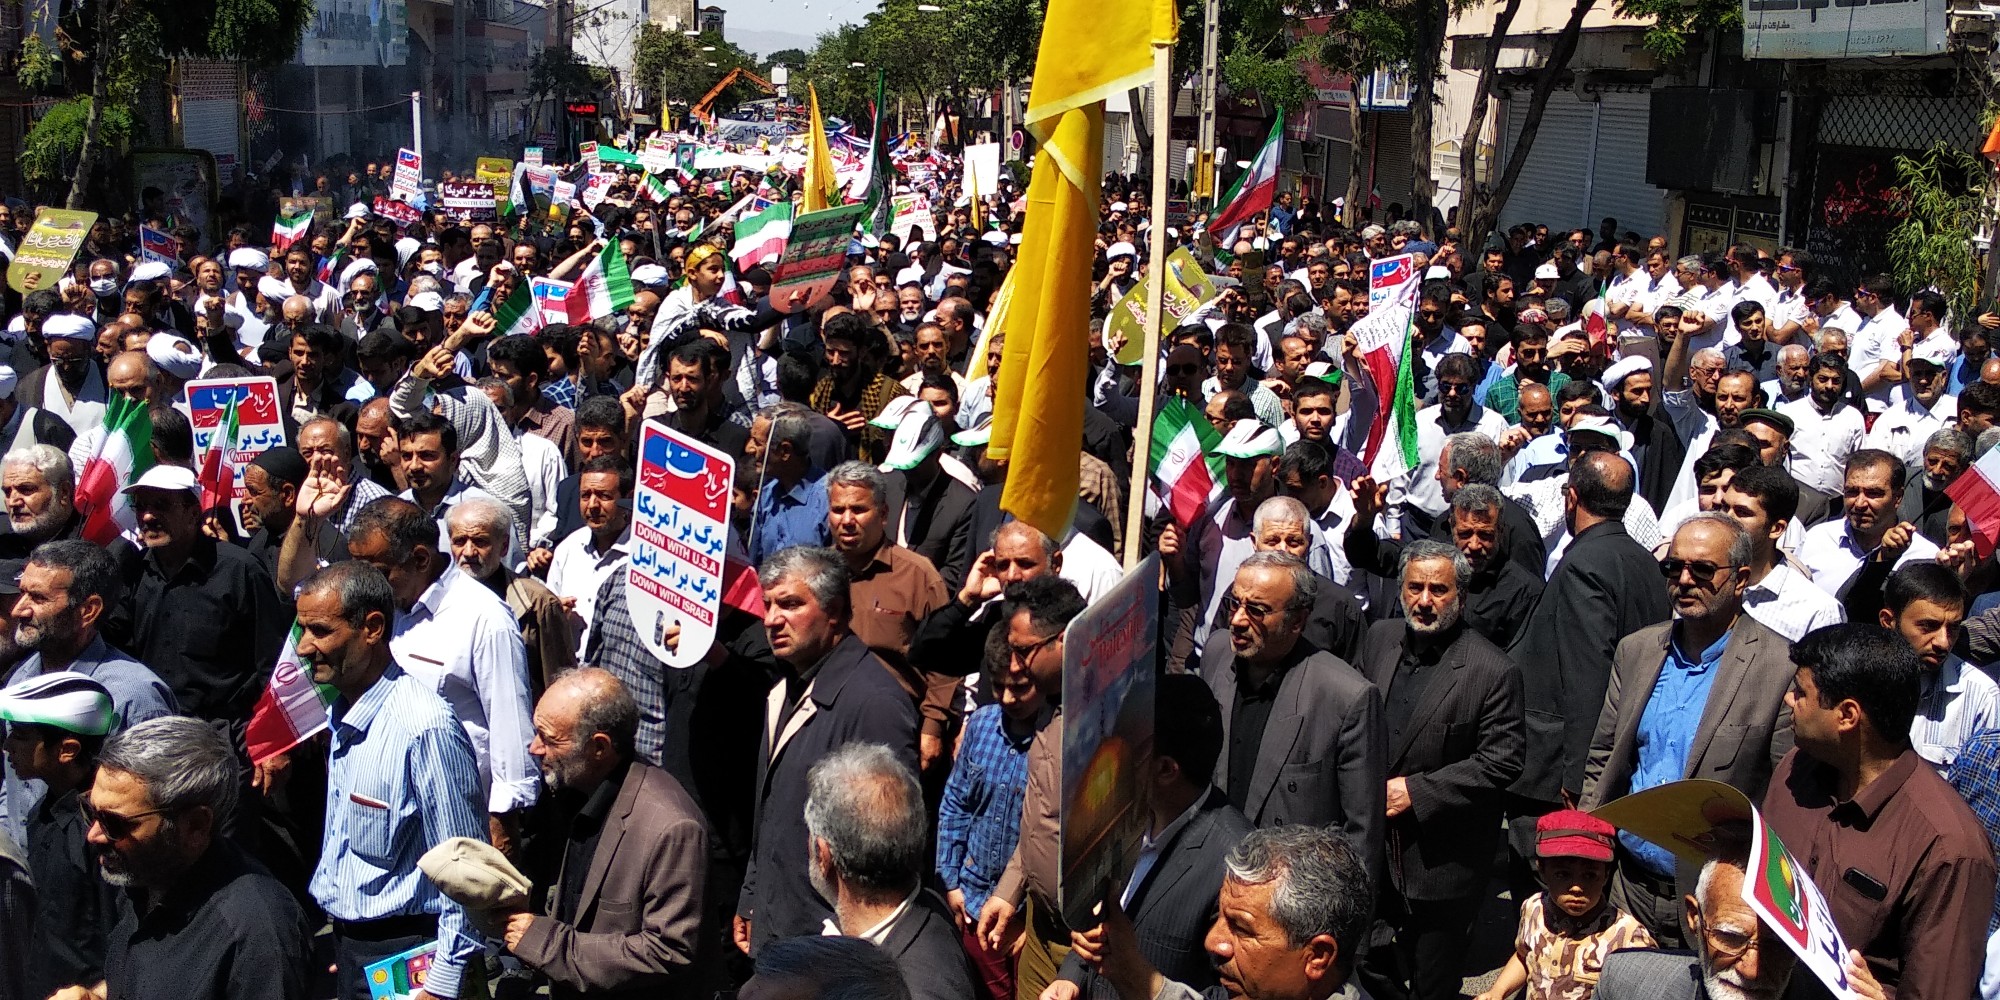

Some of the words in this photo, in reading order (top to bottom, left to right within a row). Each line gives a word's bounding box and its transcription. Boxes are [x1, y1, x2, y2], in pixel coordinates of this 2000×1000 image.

[445, 183, 468, 198] آمریکا
[467, 187, 476, 198] بر
[476, 184, 493, 198] مرگ
[1371, 287, 1392, 303] آمریکا
[253, 384, 274, 418] فریاد
[240, 433, 252, 451] بر
[253, 428, 283, 449] مرگ
[665, 440, 673, 459] ما
[665, 450, 709, 480] ملت
[704, 464, 729, 509] فریاد
[637, 490, 681, 529] آمریکا
[677, 522, 692, 543] بر
[694, 525, 724, 556] مرگ
[636, 522, 666, 548] DOWN
[666, 537, 691, 560] WITH
[691, 552, 718, 575] U.S.A
[632, 543, 677, 579] اسرائیل
[676, 573, 689, 592] بر
[691, 576, 718, 603] مرگ
[631, 572, 658, 594] DOWN
[658, 585, 681, 607] WITH
[681, 600, 712, 625] ISRAEL
